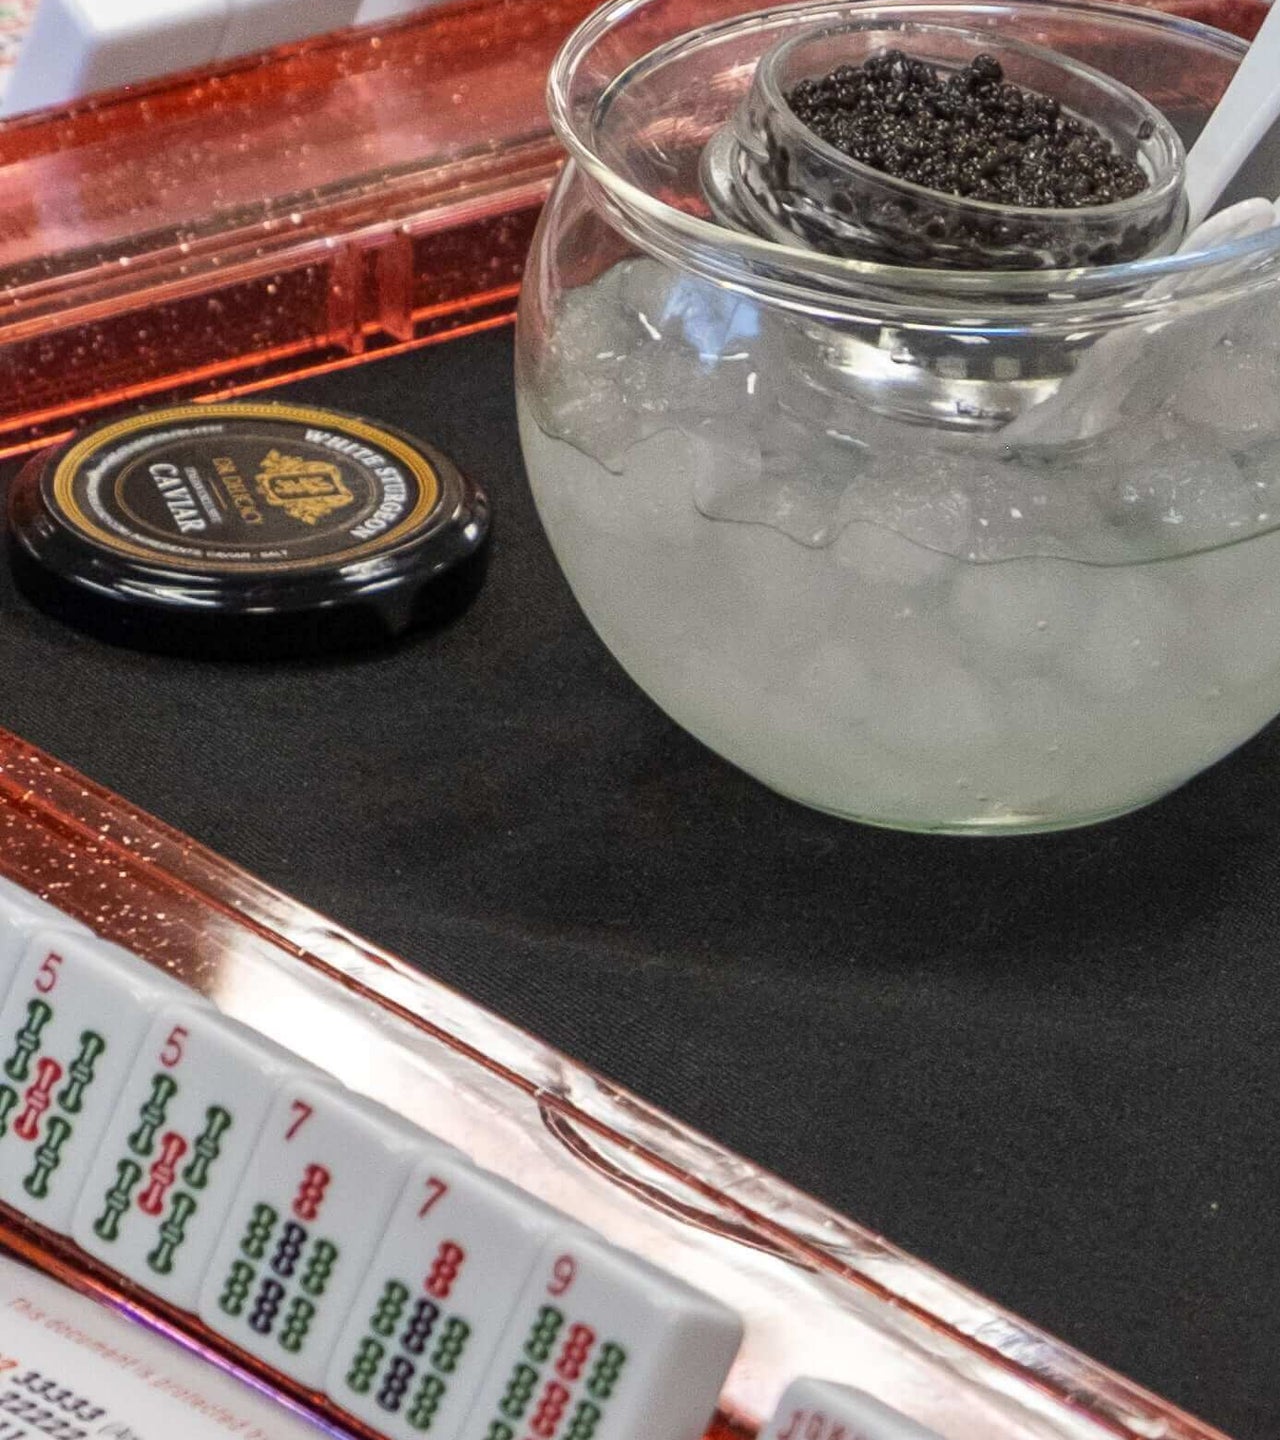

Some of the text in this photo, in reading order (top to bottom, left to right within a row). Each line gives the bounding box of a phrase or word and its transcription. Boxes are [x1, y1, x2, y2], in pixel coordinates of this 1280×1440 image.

[149, 462, 207, 534] CAVIAR
[305, 428, 407, 539] WHITE STURGEON
[35, 953, 63, 994] 5
[160, 1025, 189, 1068] 5
[283, 1098, 315, 1143] 7
[414, 1177, 449, 1220] 7
[544, 1254, 579, 1298] 9
[11, 1372, 106, 1422] 33333
